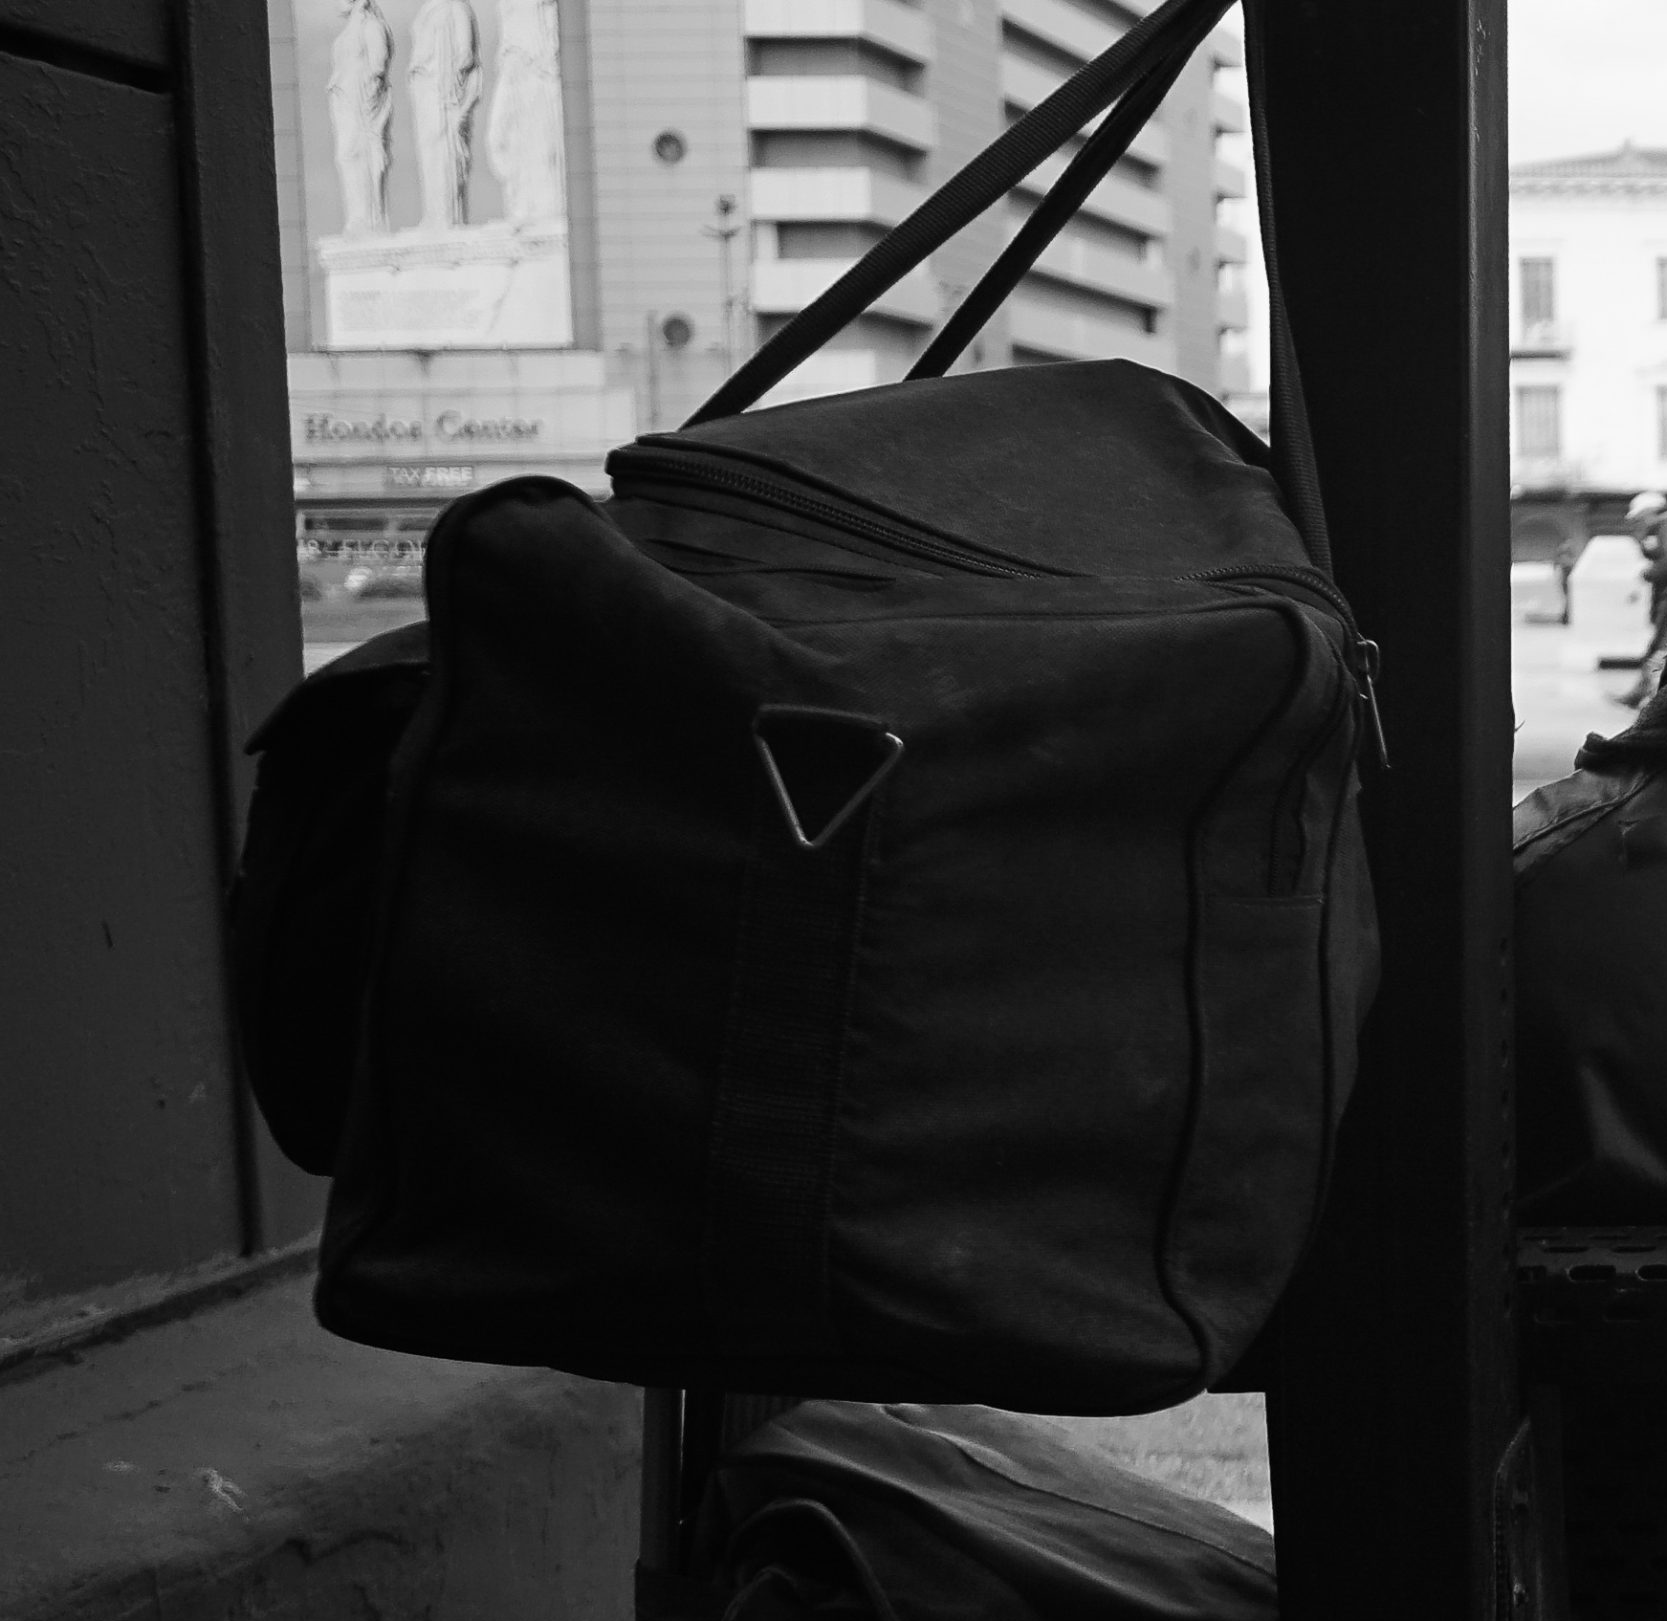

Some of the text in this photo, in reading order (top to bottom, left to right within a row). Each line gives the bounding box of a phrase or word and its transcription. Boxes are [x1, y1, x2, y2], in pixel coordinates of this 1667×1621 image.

[304, 410, 546, 443] Hondos Center
[389, 466, 474, 485] TAX FREE
